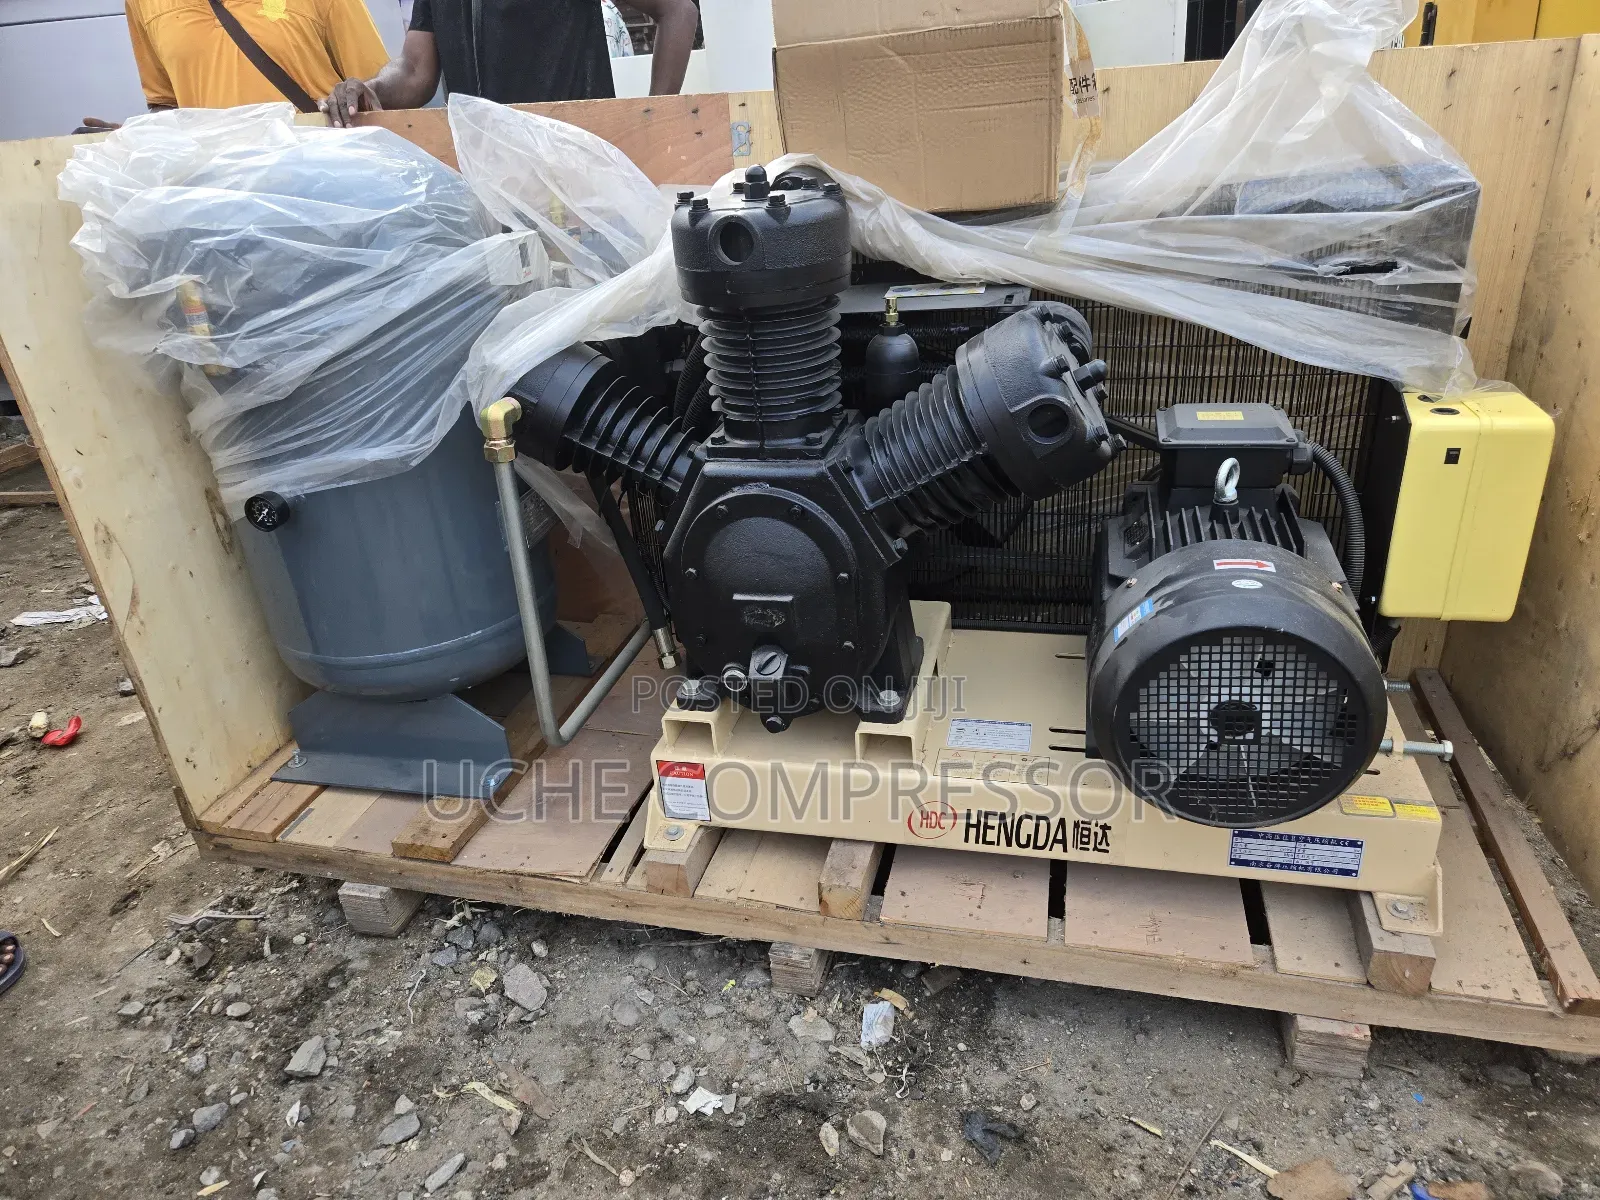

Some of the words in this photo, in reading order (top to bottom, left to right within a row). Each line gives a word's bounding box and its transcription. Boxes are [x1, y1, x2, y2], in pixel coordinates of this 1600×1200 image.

[919, 811, 946, 830] HDC
[963, 808, 1068, 853] HENGDA
[1072, 819, 1112, 853] 恒达
